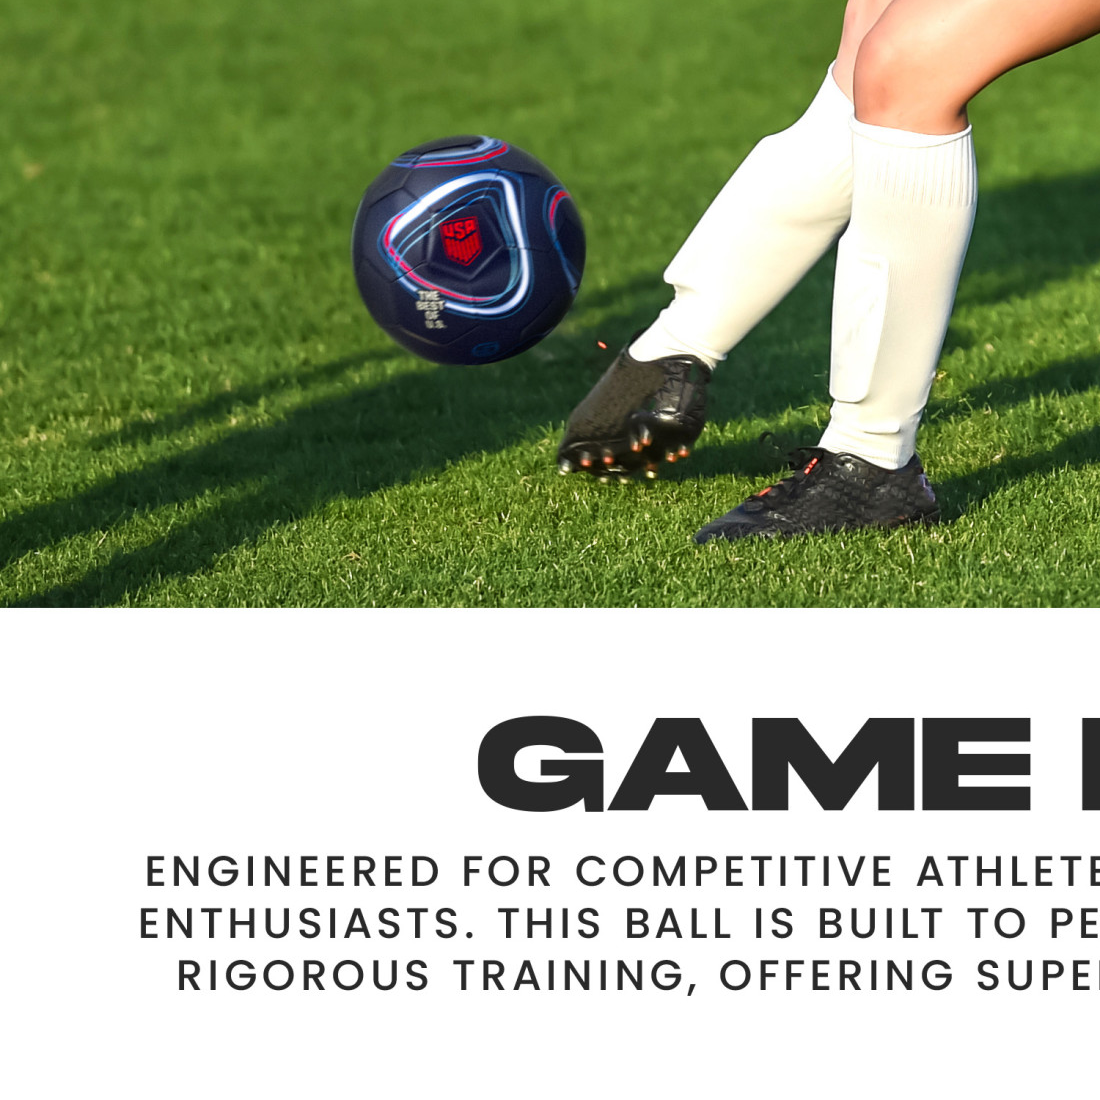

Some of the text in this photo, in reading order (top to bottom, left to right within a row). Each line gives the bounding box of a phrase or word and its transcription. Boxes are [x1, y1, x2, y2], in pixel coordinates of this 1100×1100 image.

[443, 219, 476, 240] USA
[417, 290, 440, 301] THE
[416, 300, 445, 311] BEST
